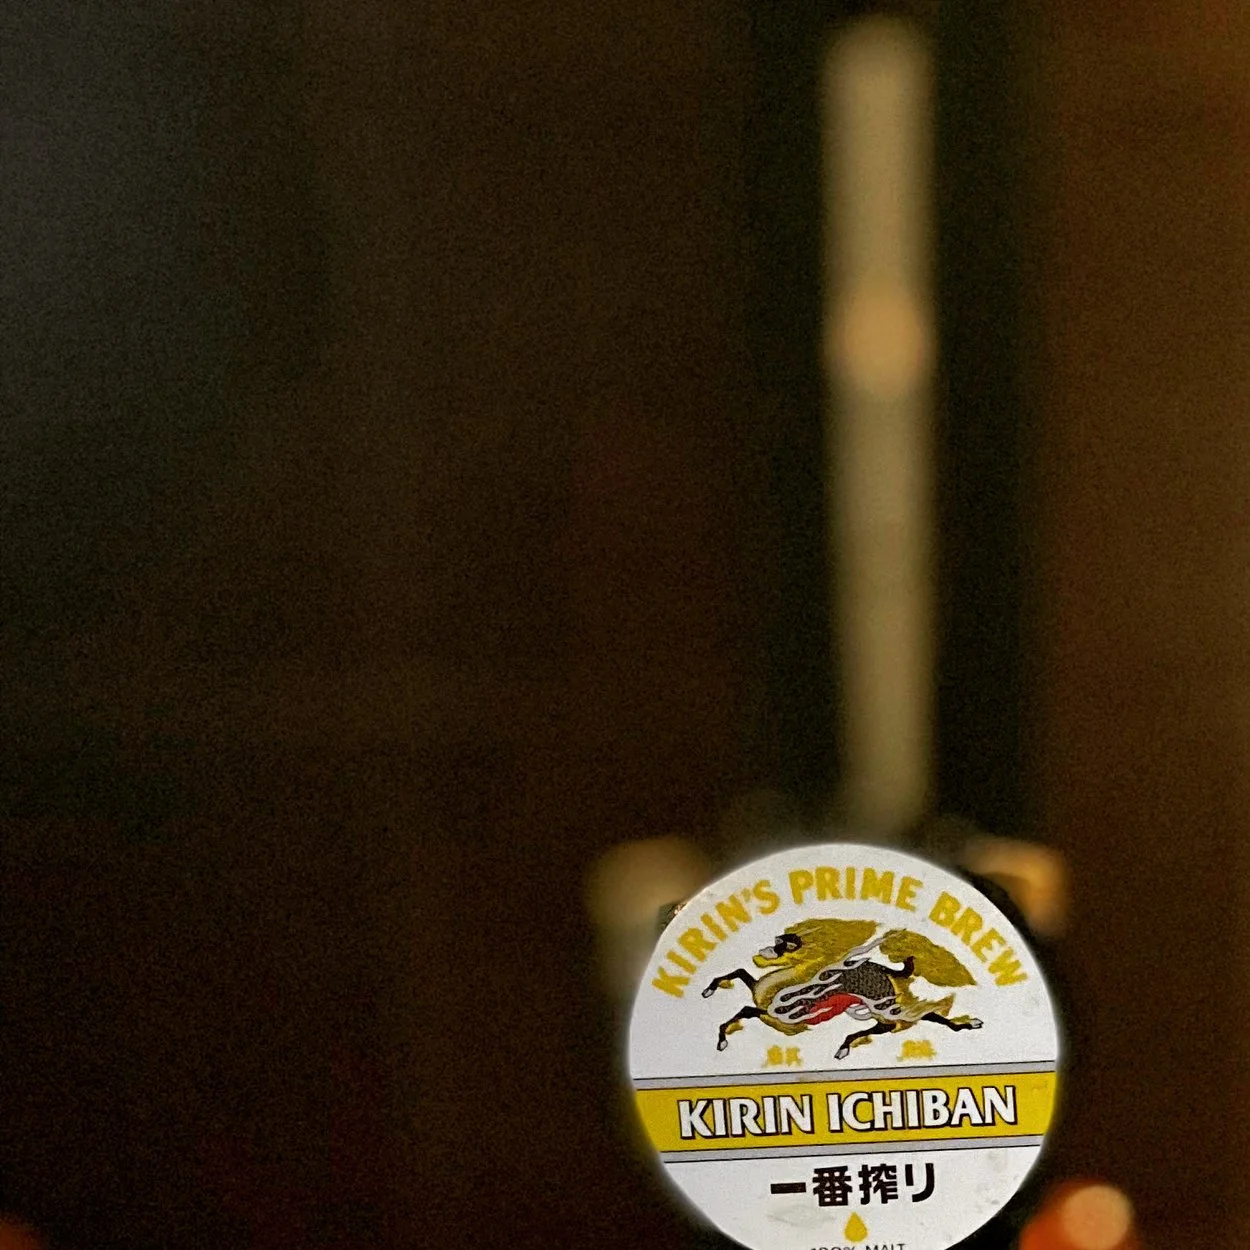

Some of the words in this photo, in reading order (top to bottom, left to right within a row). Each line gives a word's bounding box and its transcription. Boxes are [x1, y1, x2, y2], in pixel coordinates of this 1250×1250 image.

[651, 879, 780, 999] KIRIN'S
[788, 866, 924, 912] PRIME
[928, 890, 1028, 987] BREW
[678, 1095, 814, 1139] KIRIN
[828, 1085, 1018, 1132] ICHIBAN
[769, 1162, 936, 1207] 一番搾り
